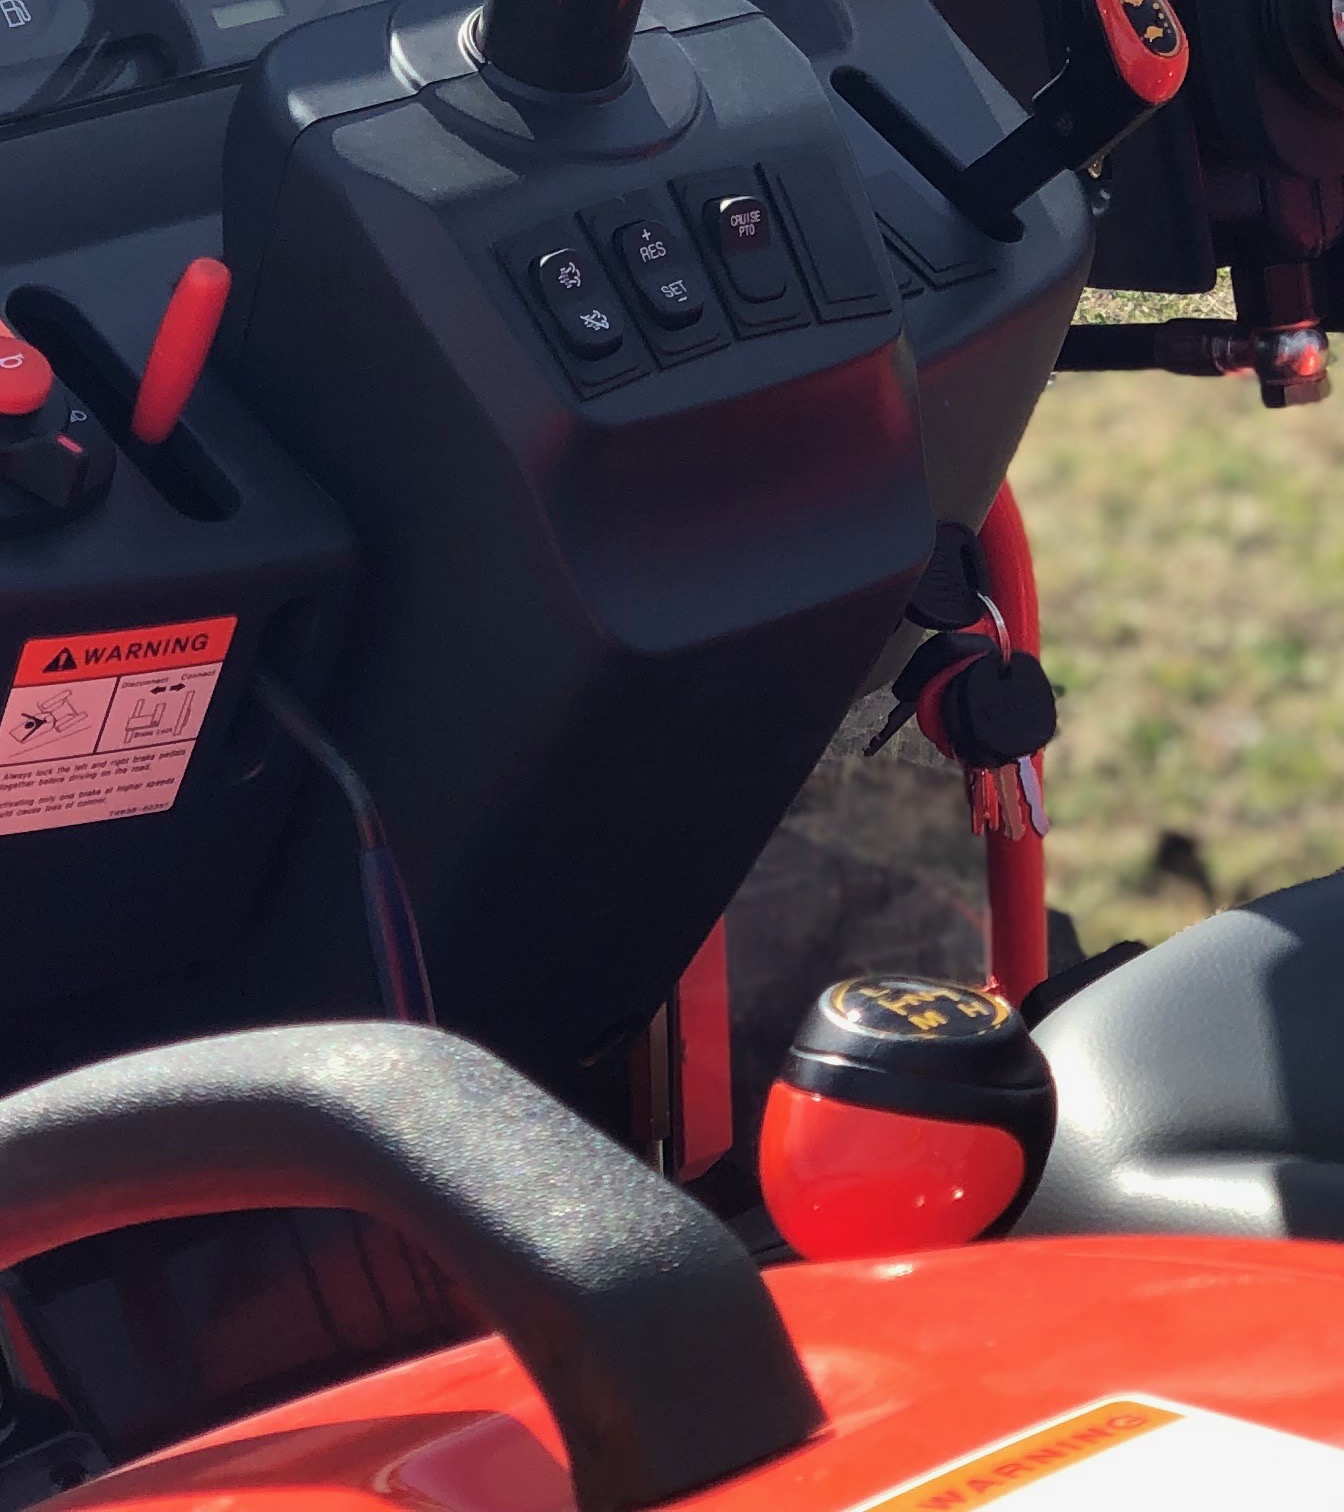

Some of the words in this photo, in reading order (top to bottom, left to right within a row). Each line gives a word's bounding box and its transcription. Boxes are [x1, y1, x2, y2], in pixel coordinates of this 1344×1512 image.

[730, 209, 761, 227] CRUISE
[738, 224, 756, 237] PTO
[639, 241, 667, 262] RES
[660, 279, 688, 298] SET
[83, 633, 209, 665] WARNING
[916, 1414, 1148, 1510] WARNING
